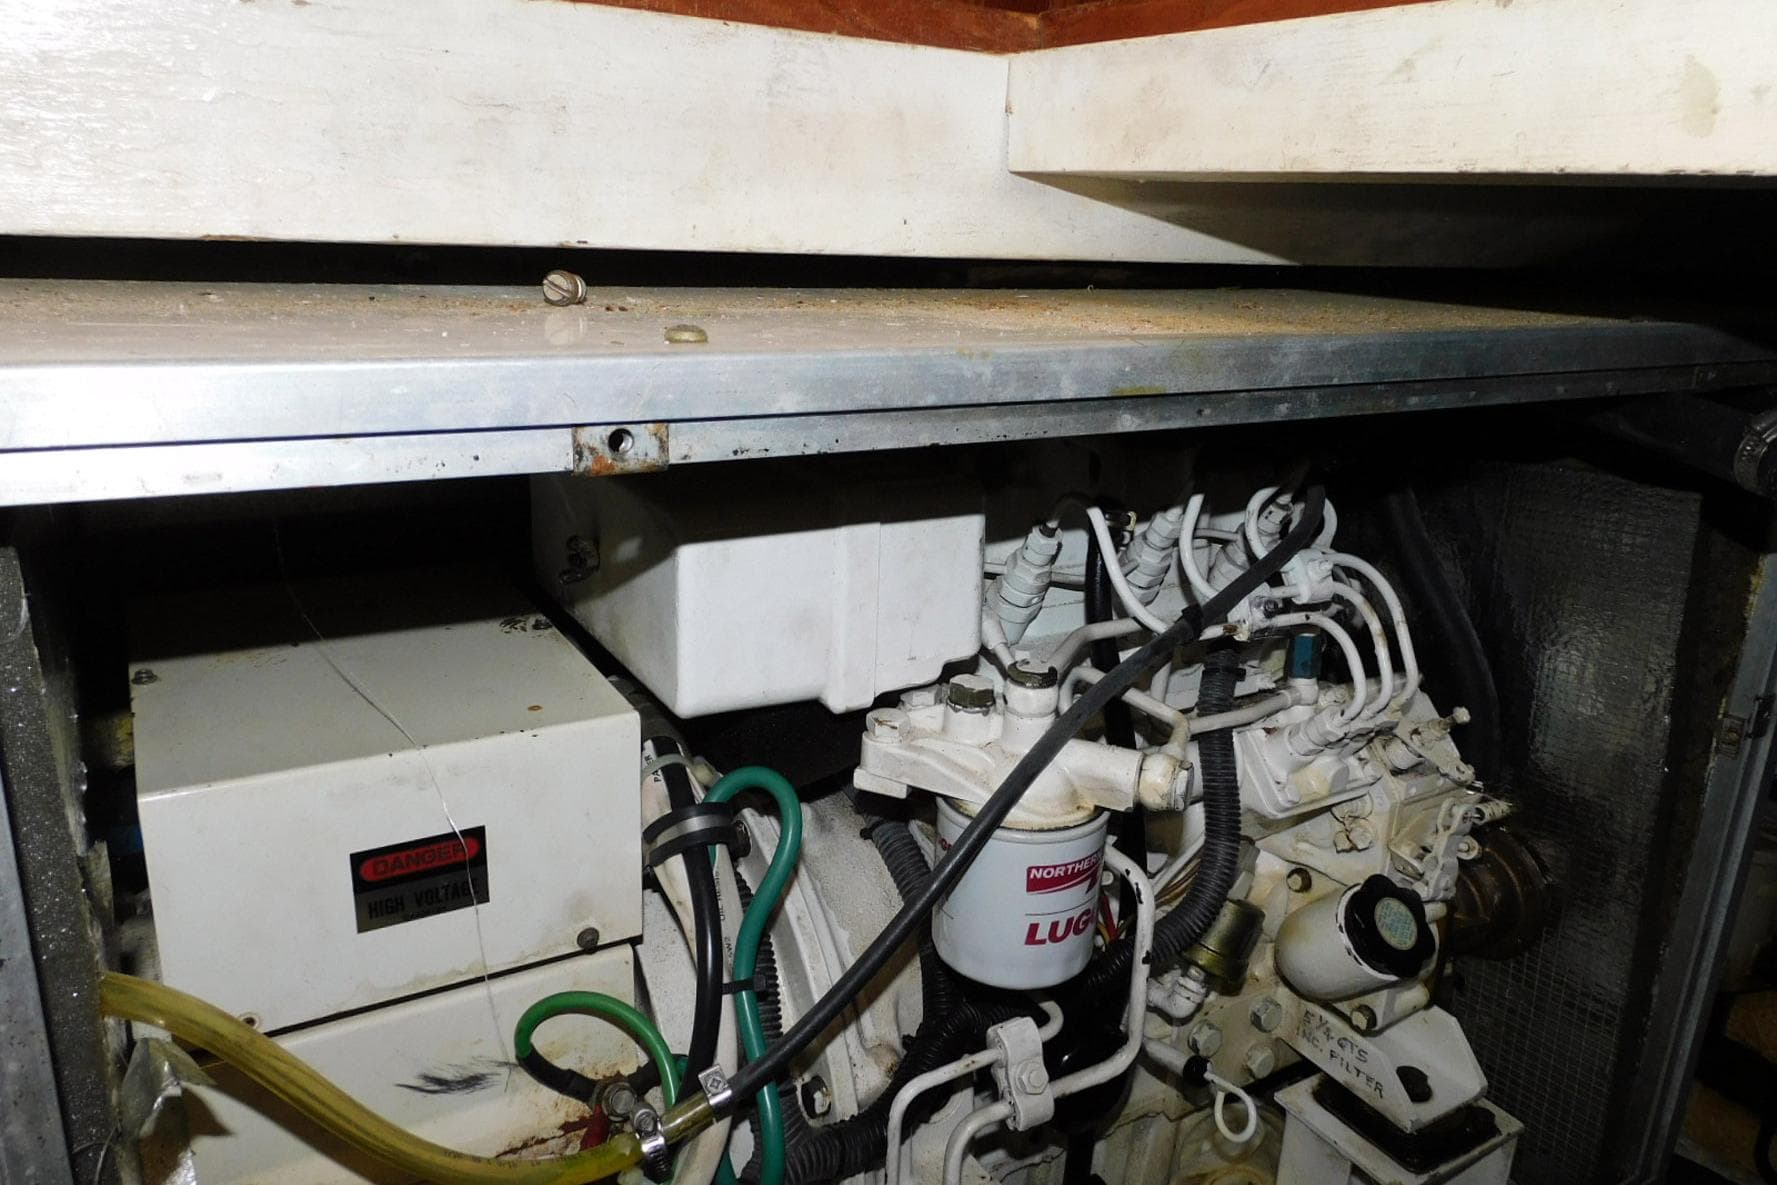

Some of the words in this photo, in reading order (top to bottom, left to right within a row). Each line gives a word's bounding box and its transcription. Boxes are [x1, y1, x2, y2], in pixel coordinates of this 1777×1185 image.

[372, 841, 467, 876] DANGER
[368, 896, 404, 920] HIGH
[414, 877, 479, 908] VOLTAGE
[1329, 1048, 1384, 1099] FILTER
